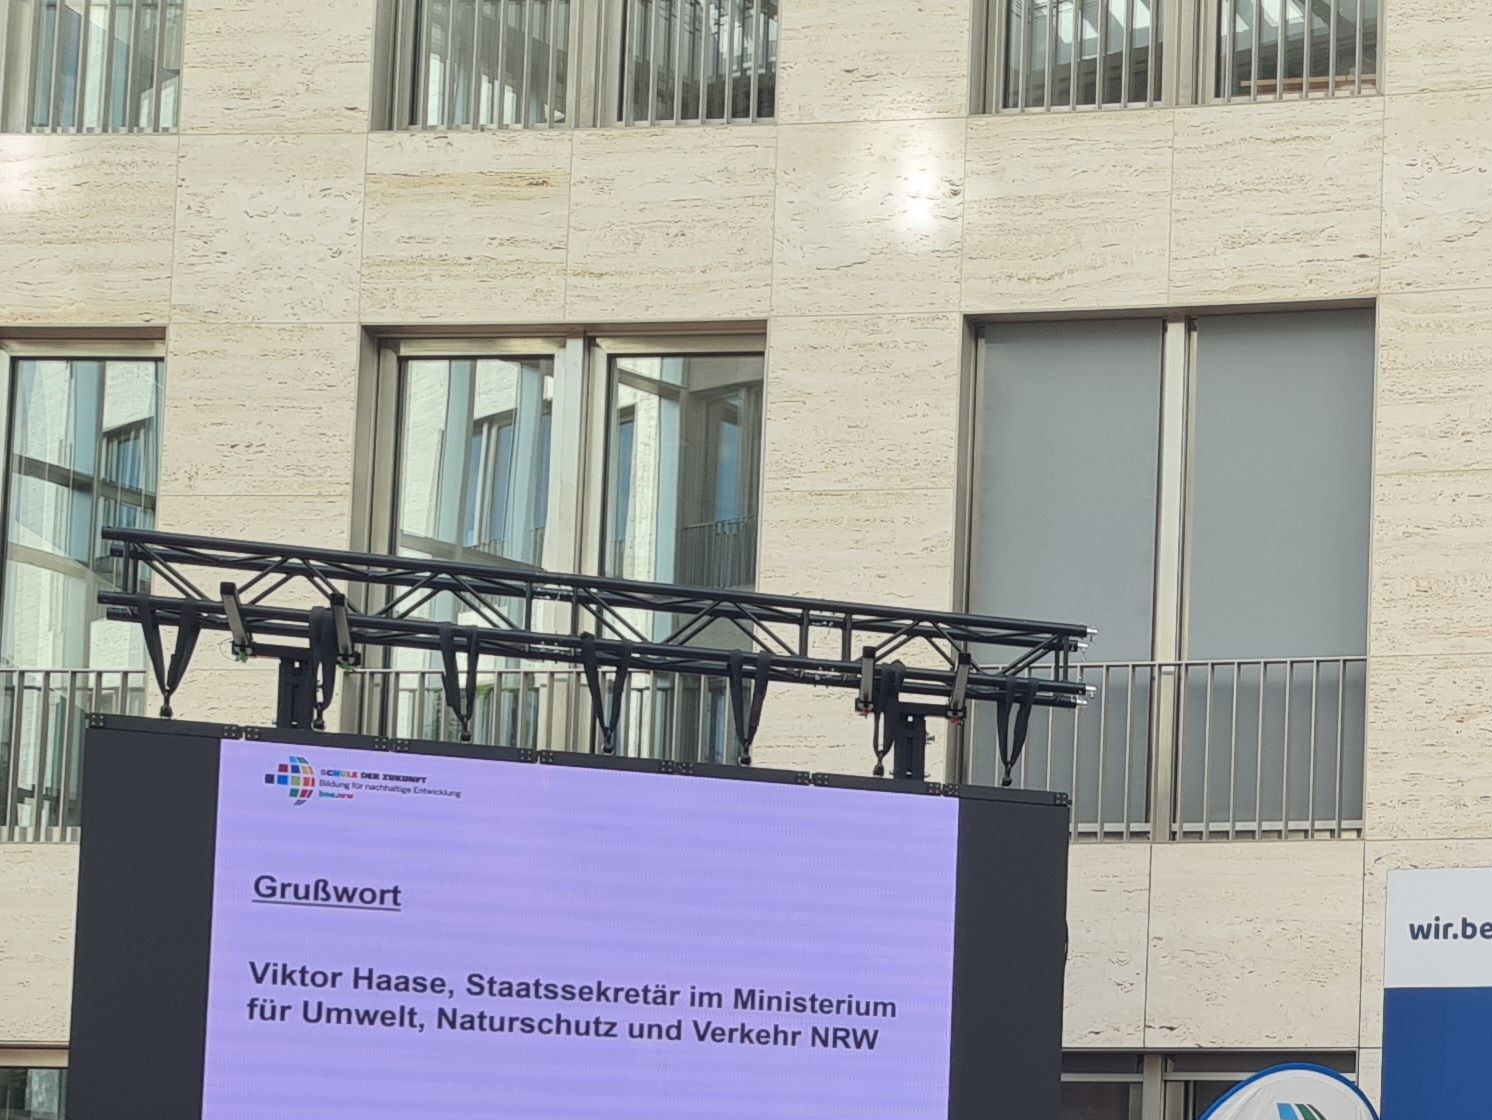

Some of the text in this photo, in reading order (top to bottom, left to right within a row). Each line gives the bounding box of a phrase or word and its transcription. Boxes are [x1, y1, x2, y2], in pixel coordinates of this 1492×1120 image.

[319, 780, 350, 790] Bildung
[365, 783, 411, 795] nachhaltige
[413, 786, 461, 798] Entwicklung
[253, 874, 402, 908] Grußwort
[248, 961, 897, 1018] Viktor Haase, Staatssekretär im Ministerium
[247, 997, 880, 1051] für Umwelt, Naturschutz und Verkehr NRW
